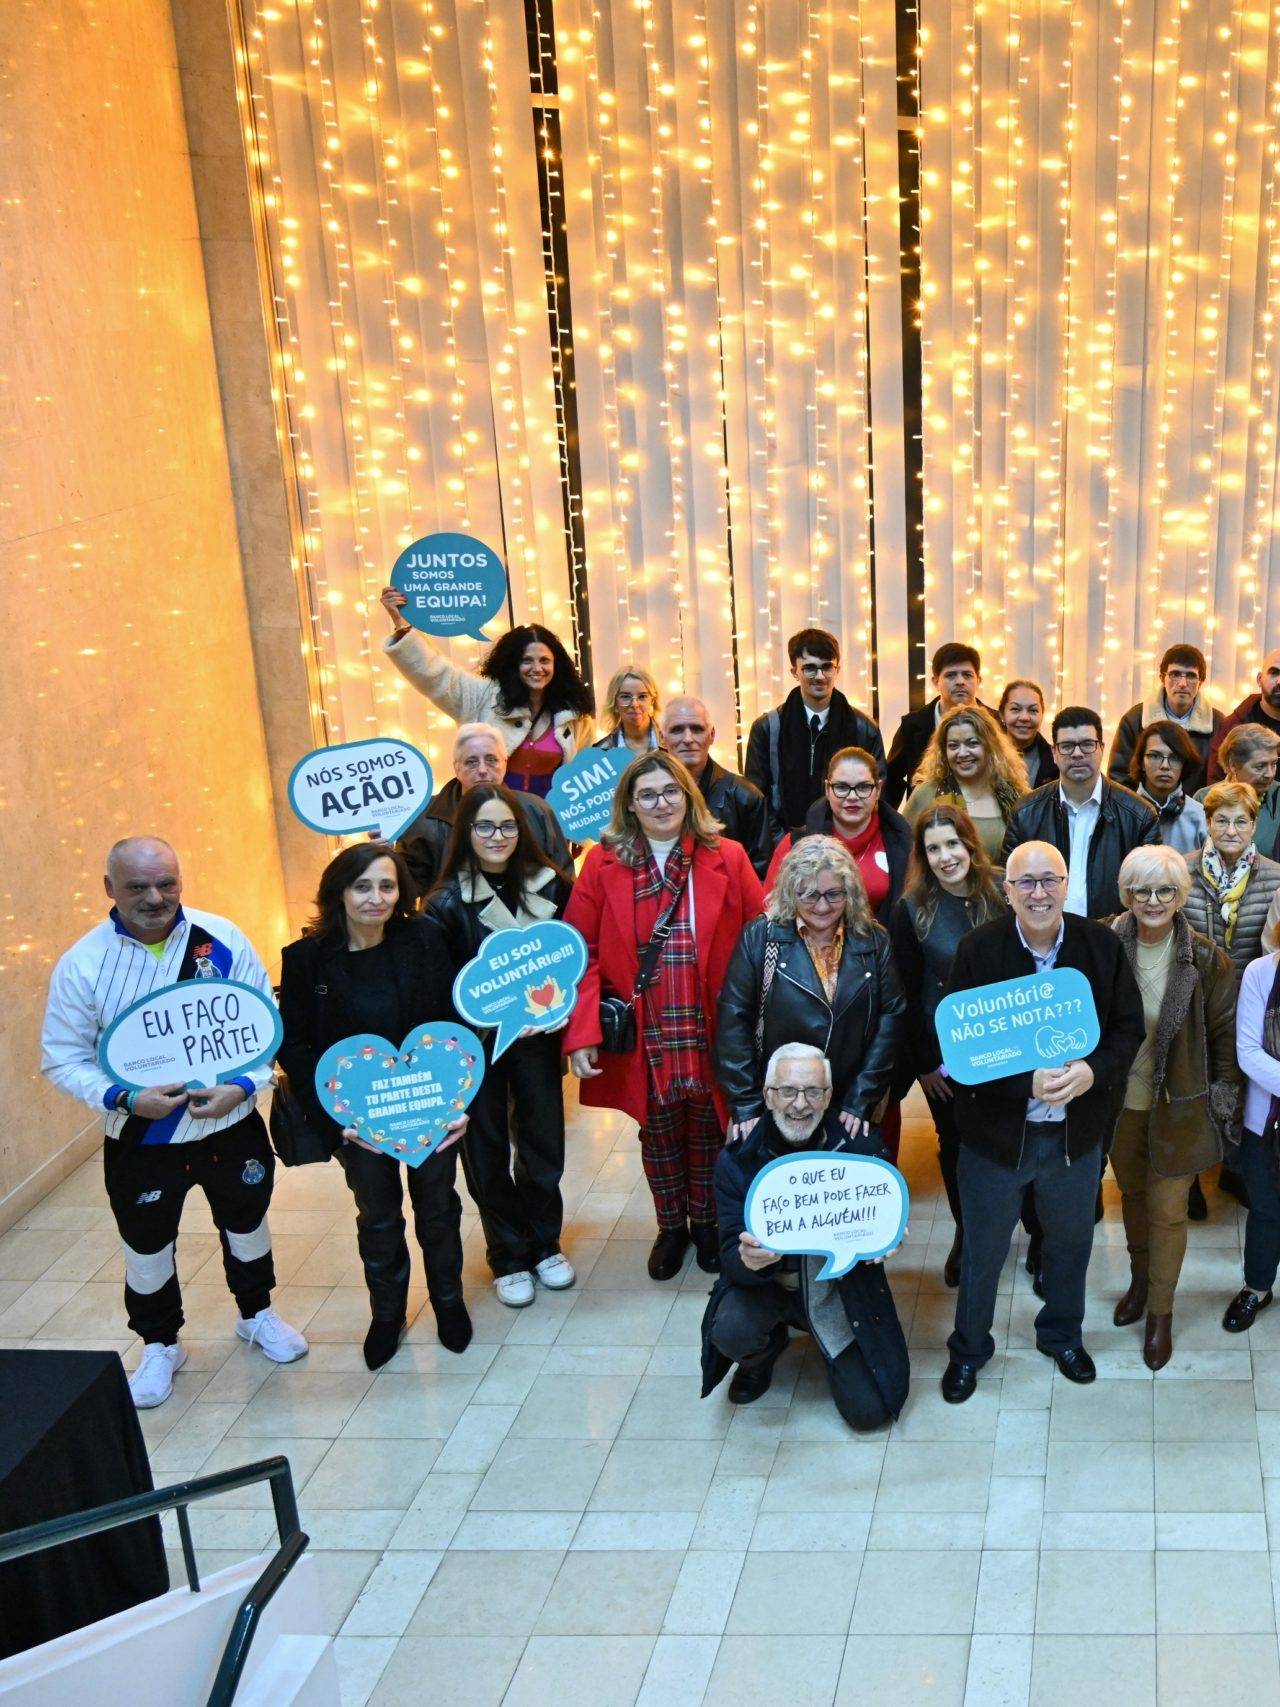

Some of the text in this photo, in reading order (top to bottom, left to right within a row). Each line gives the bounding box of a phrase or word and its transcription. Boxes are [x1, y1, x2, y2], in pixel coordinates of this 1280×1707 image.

[406, 553, 488, 568] JUNTOS
[412, 570, 455, 580] SOMOS
[403, 582, 483, 592] UMA GRANDE
[415, 595, 487, 608] EQUIPA!
[306, 750, 406, 788] NÓS SOMOS
[561, 757, 617, 801] SIM!
[321, 771, 415, 818] AÇÃO!
[560, 802, 586, 821] NÓS
[568, 812, 602, 831] MUDAR
[602, 809, 610, 817] O
[489, 938, 542, 971] EU SOU
[468, 943, 575, 999] VOLUNTÁRI@!!!
[952, 982, 1055, 1020] Voluntári@
[142, 993, 240, 1038] EU FAÇO
[951, 998, 1082, 1043] NÃO SE NOTA???
[182, 1023, 261, 1066] PARTE!
[969, 1052, 992, 1061] BANCO
[992, 1047, 1012, 1056] LOCAL
[125, 1056, 176, 1071] VOLUNTARIADO
[971, 1050, 1023, 1067] VOLUNTARIADO
[371, 1070, 433, 1091] FAZ TAMBÉM
[365, 1082, 443, 1105] TU PARTE DESTA
[368, 1096, 446, 1119] GRANDE EQUIPA.
[789, 1167, 846, 1185] O QUE EU
[763, 1183, 892, 1215] FAÇO BEM PODE FAZER
[766, 1206, 876, 1237] BEM A ALGUÉM!!!
